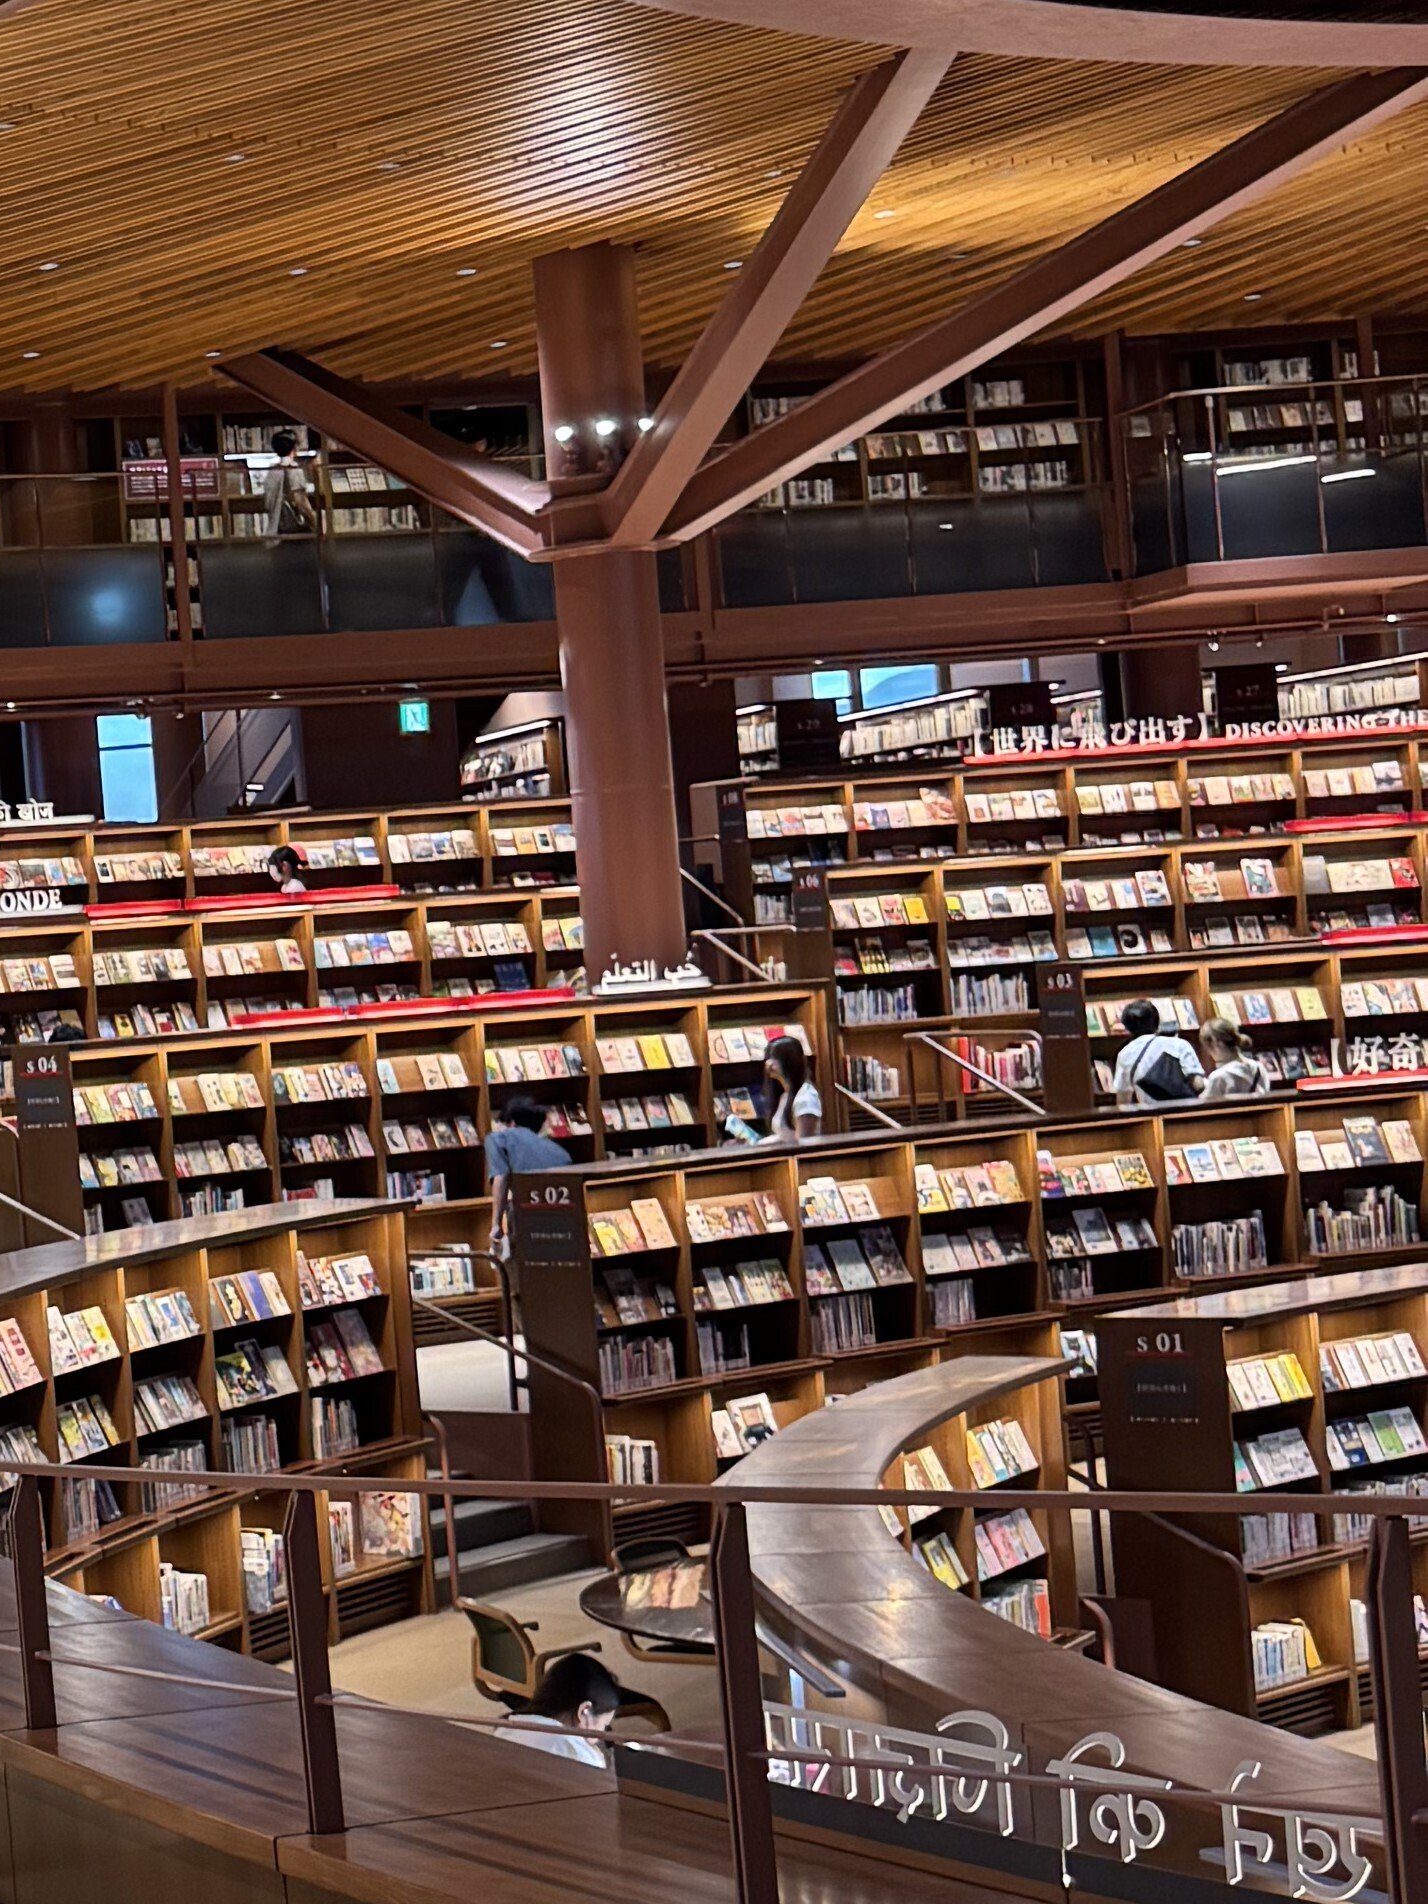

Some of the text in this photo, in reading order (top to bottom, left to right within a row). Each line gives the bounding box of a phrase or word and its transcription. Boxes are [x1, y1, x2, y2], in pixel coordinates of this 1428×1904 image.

[1225, 714, 1377, 739] DISCOVERING
[16, 798, 53, 820] खोज
[38, 1056, 57, 1073] 04
[545, 1186, 571, 1204] 02
[1156, 1332, 1183, 1352] 01
